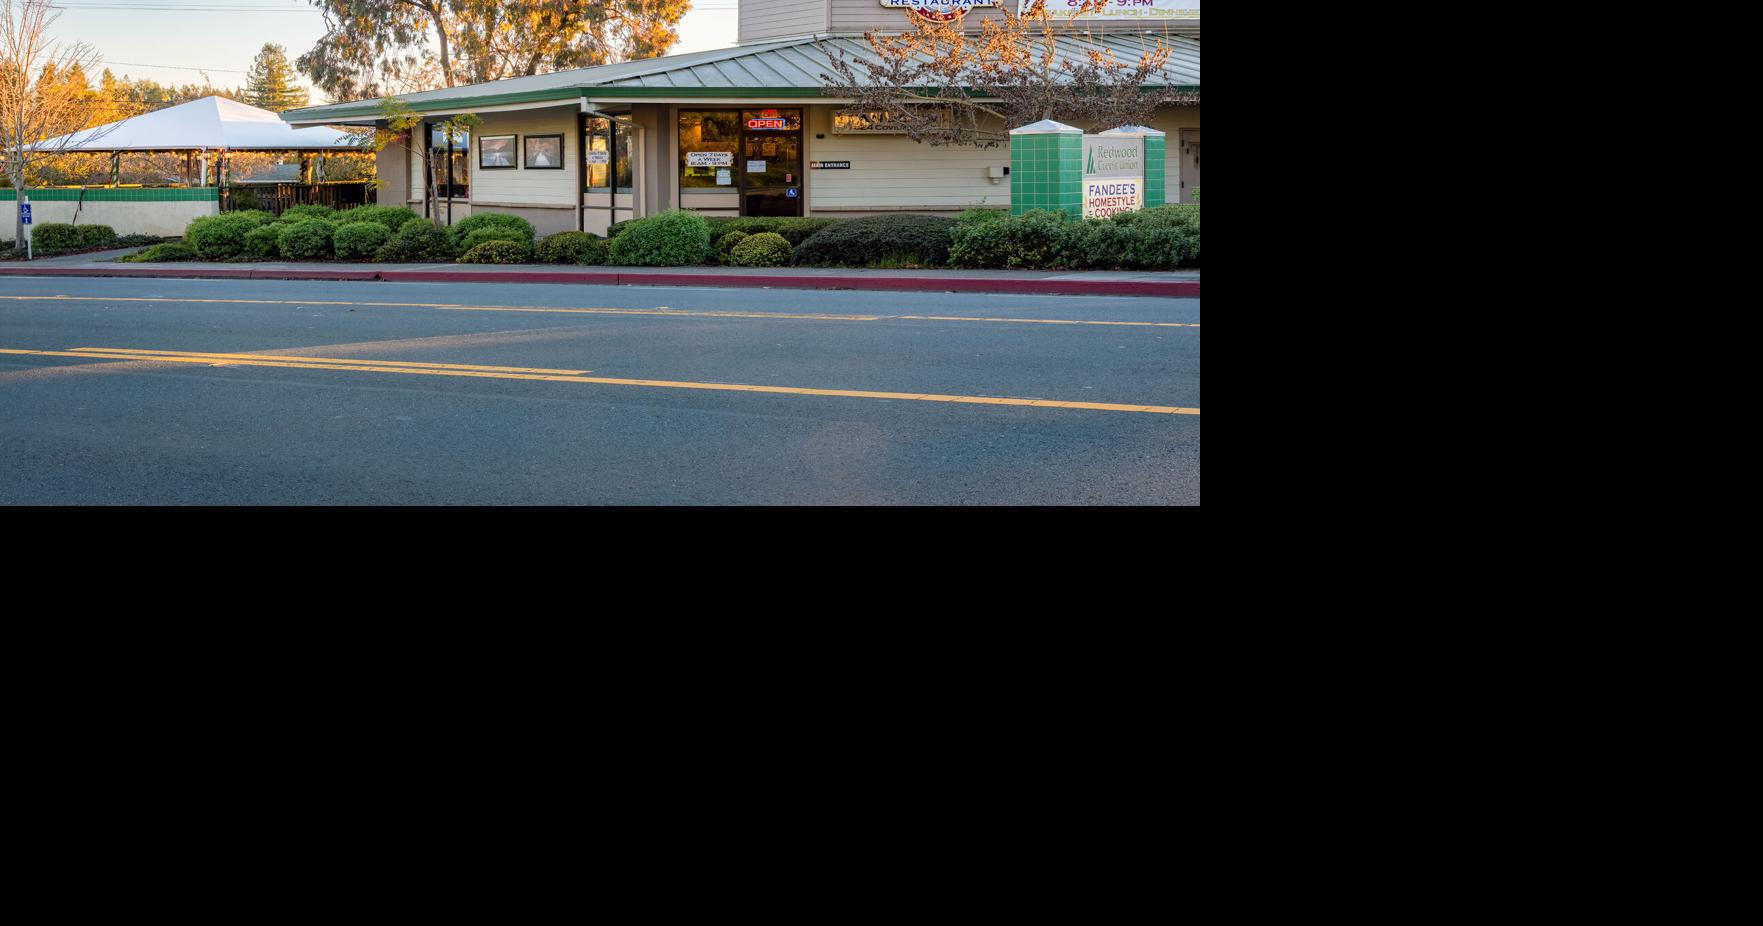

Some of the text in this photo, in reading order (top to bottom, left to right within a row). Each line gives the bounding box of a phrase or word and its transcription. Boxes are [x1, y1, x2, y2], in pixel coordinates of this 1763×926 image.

[748, 120, 783, 128] OPEN
[1098, 145, 1138, 159] Redwood
[1119, 160, 1137, 170] Union
[1089, 183, 1136, 197] FANDEE'S
[1089, 196, 1136, 208] HOMESTYLE
